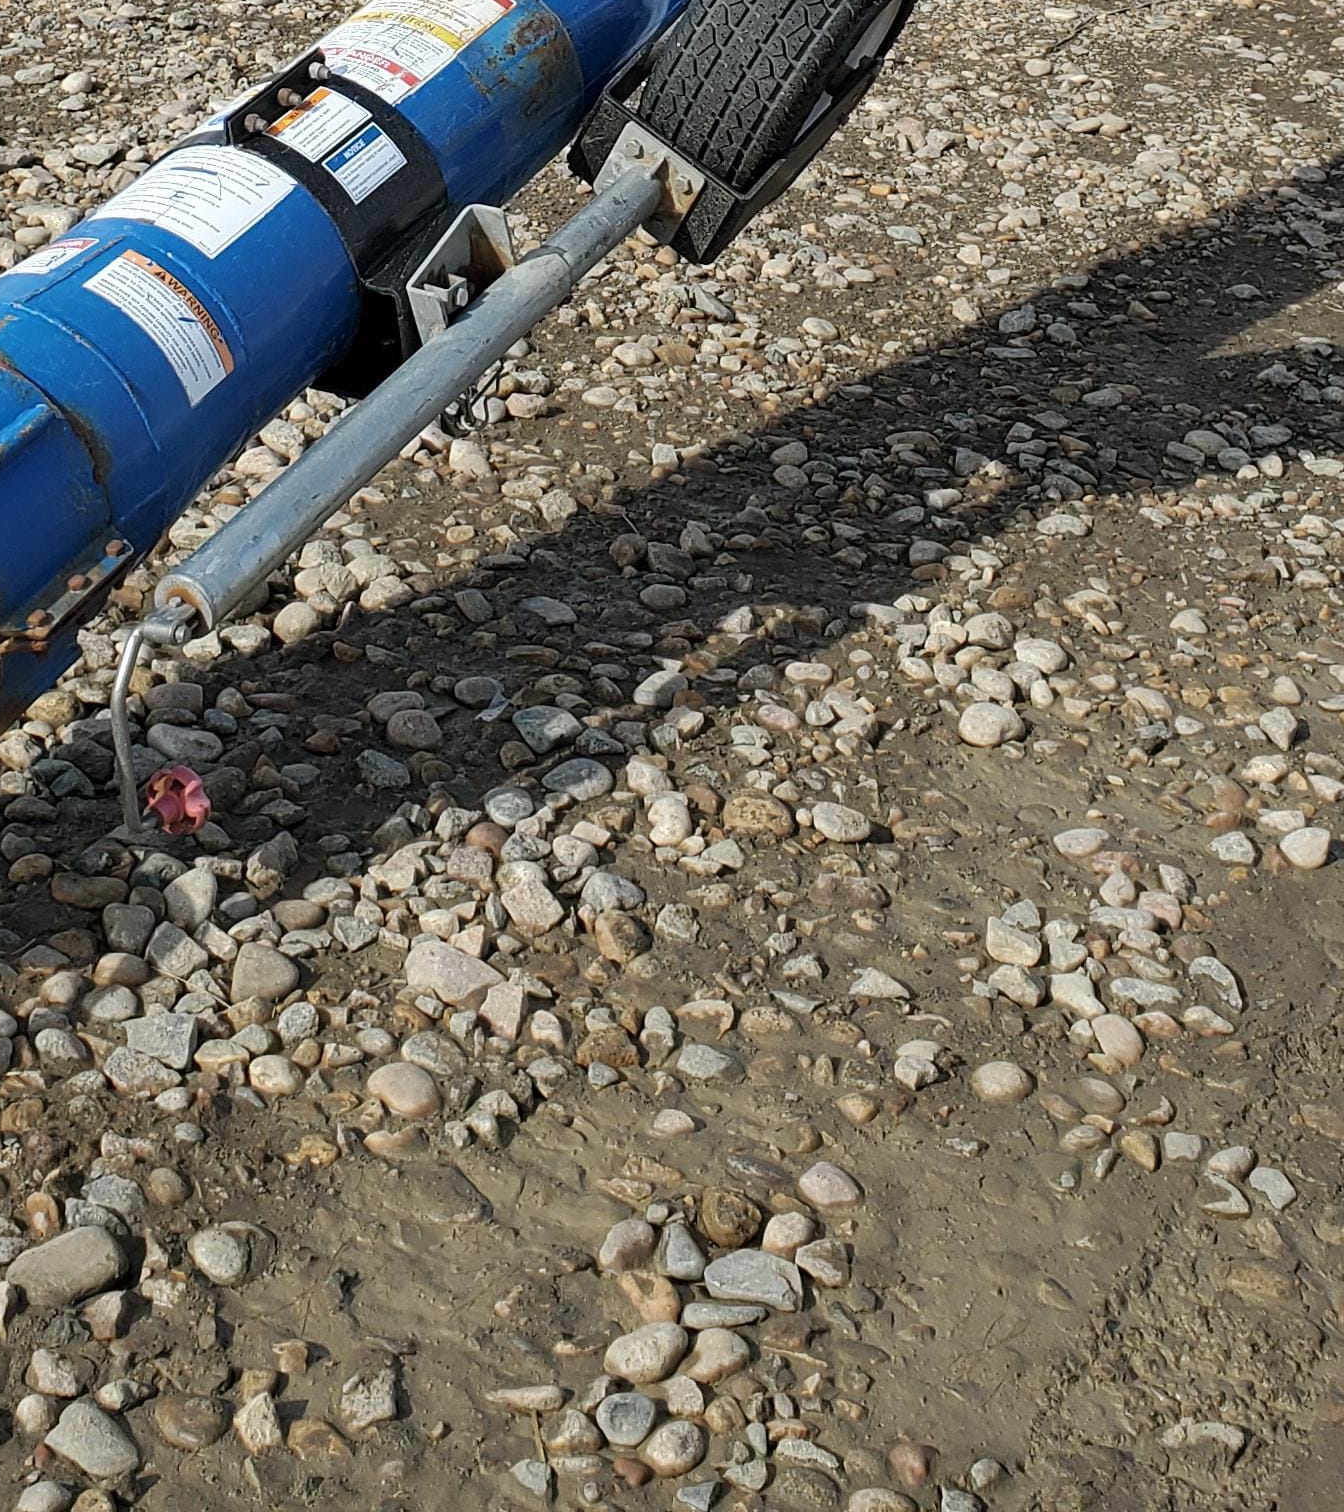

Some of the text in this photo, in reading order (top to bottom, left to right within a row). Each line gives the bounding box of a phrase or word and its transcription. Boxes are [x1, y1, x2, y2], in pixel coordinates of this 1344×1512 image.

[383, 11, 436, 32] CUTION
[346, 49, 391, 68] ANGER
[343, 138, 366, 160] NOTICE
[167, 276, 220, 342] WARNING
